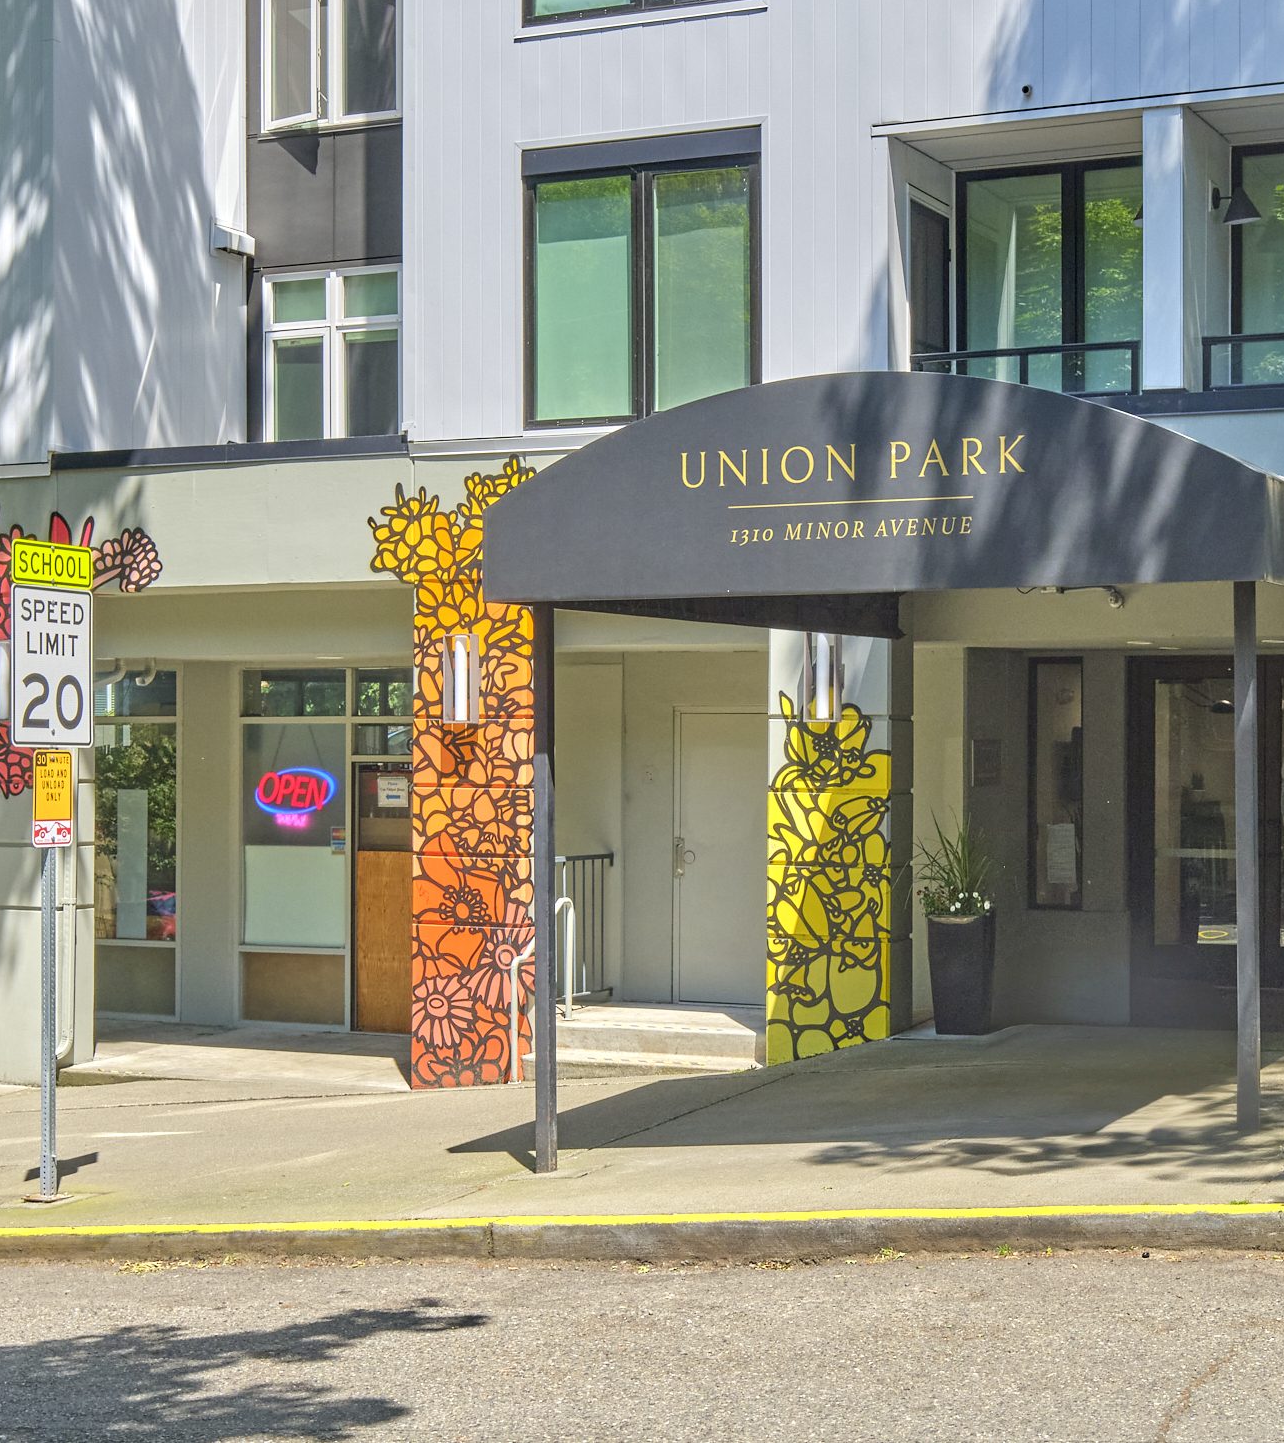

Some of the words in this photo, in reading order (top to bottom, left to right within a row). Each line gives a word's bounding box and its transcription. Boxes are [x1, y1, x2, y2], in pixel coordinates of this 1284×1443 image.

[681, 443, 857, 489] UNION
[889, 434, 1027, 480] PARK
[729, 527, 774, 547] 1310
[783, 520, 866, 542] MINOR
[873, 515, 974, 539] AVENUE
[19, 550, 87, 580] SCHOOL
[20, 598, 84, 626] SPEED
[26, 631, 79, 657] LIMIT
[21, 672, 84, 730] 20
[37, 754, 47, 765] 30
[49, 756, 70, 765] MNUTE
[39, 768, 55, 779] LOAD
[57, 768, 68, 779] AND
[41, 779, 65, 790] UNLOAD
[46, 791, 62, 802] ONLY
[258, 771, 329, 811] OPEN
